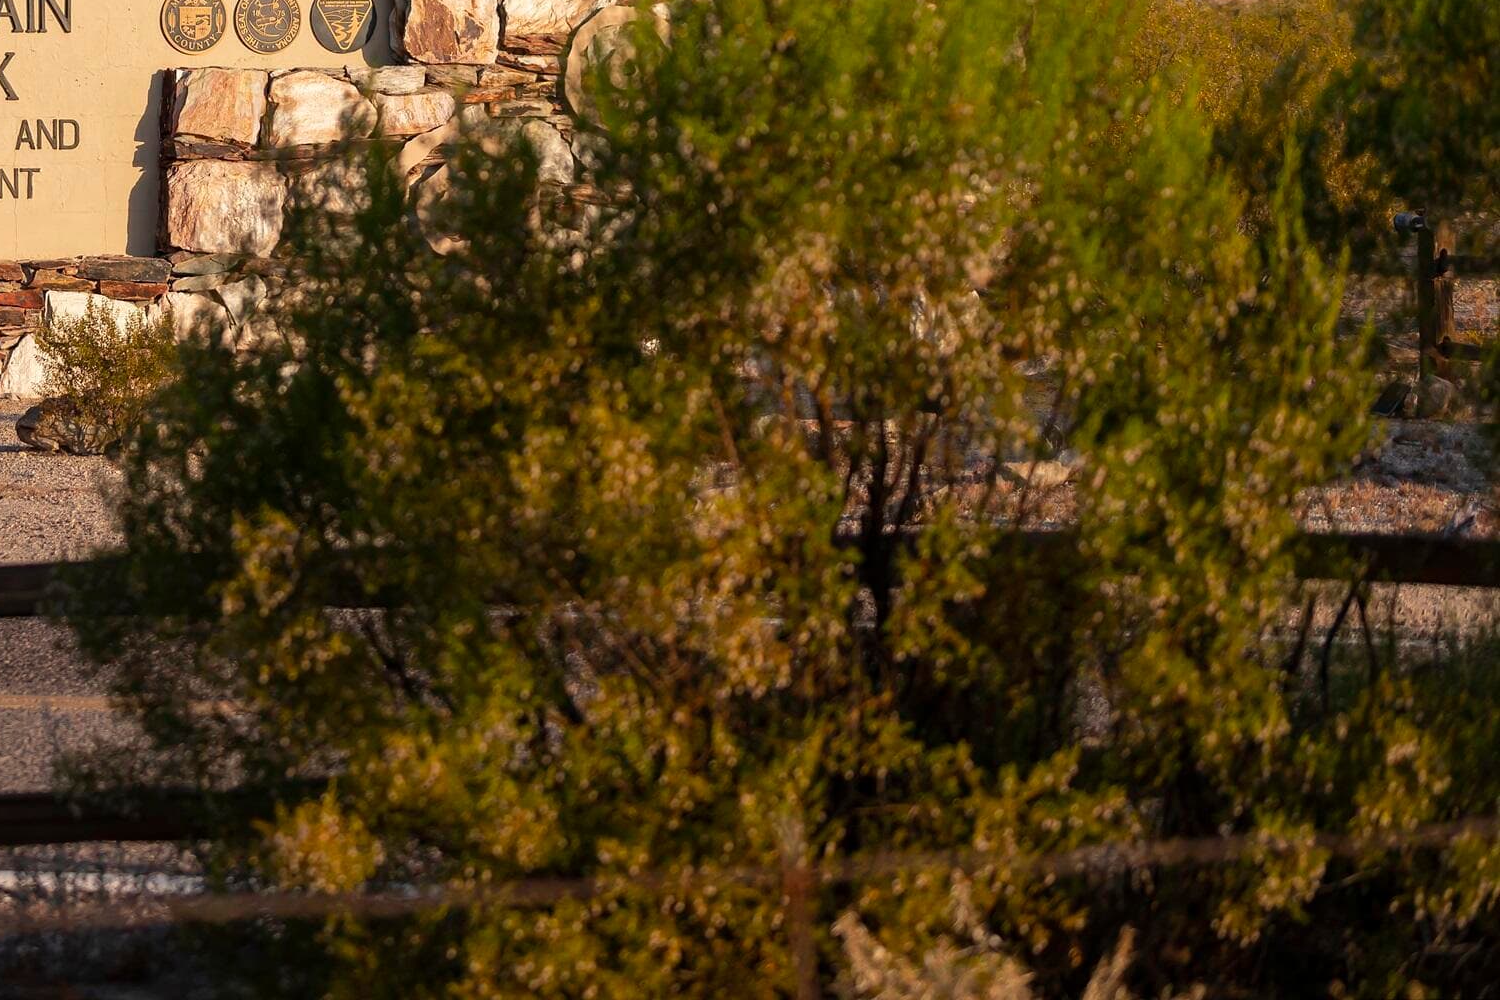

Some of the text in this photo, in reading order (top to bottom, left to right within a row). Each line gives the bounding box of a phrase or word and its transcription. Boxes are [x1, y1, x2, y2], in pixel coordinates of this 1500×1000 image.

[238, 10, 248, 35] SEAL
[275, 16, 299, 49] ARIZONA
[174, 34, 217, 50] COUNTY
[245, 33, 260, 49] THE
[15, 118, 80, 150] AND
